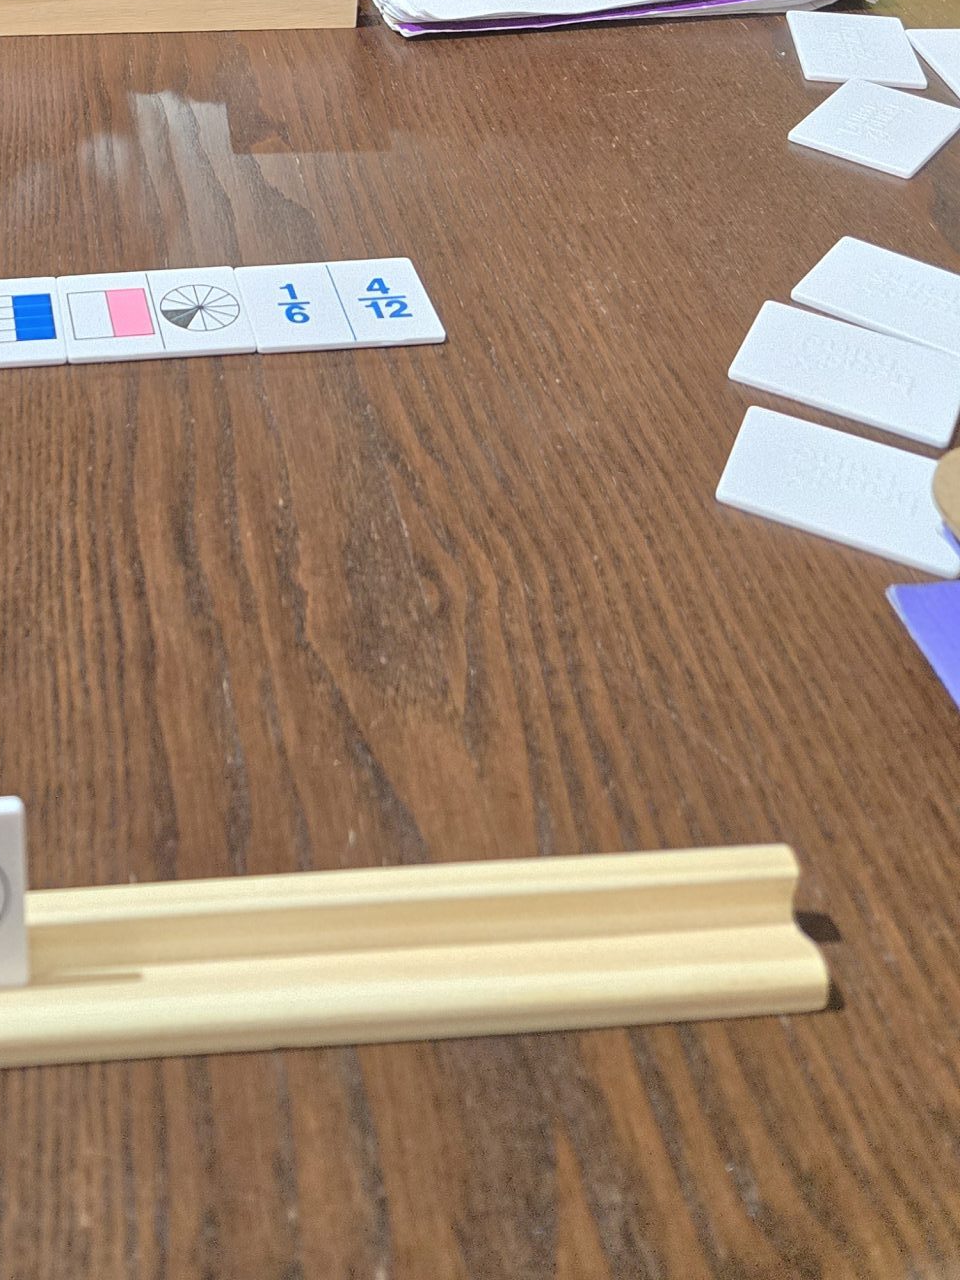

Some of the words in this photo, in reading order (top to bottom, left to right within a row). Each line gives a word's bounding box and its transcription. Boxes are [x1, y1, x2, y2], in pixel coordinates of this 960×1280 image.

[279, 283, 298, 300] 1
[366, 277, 391, 295] 4
[284, 304, 311, 324] 6
[364, 299, 414, 319] 12
